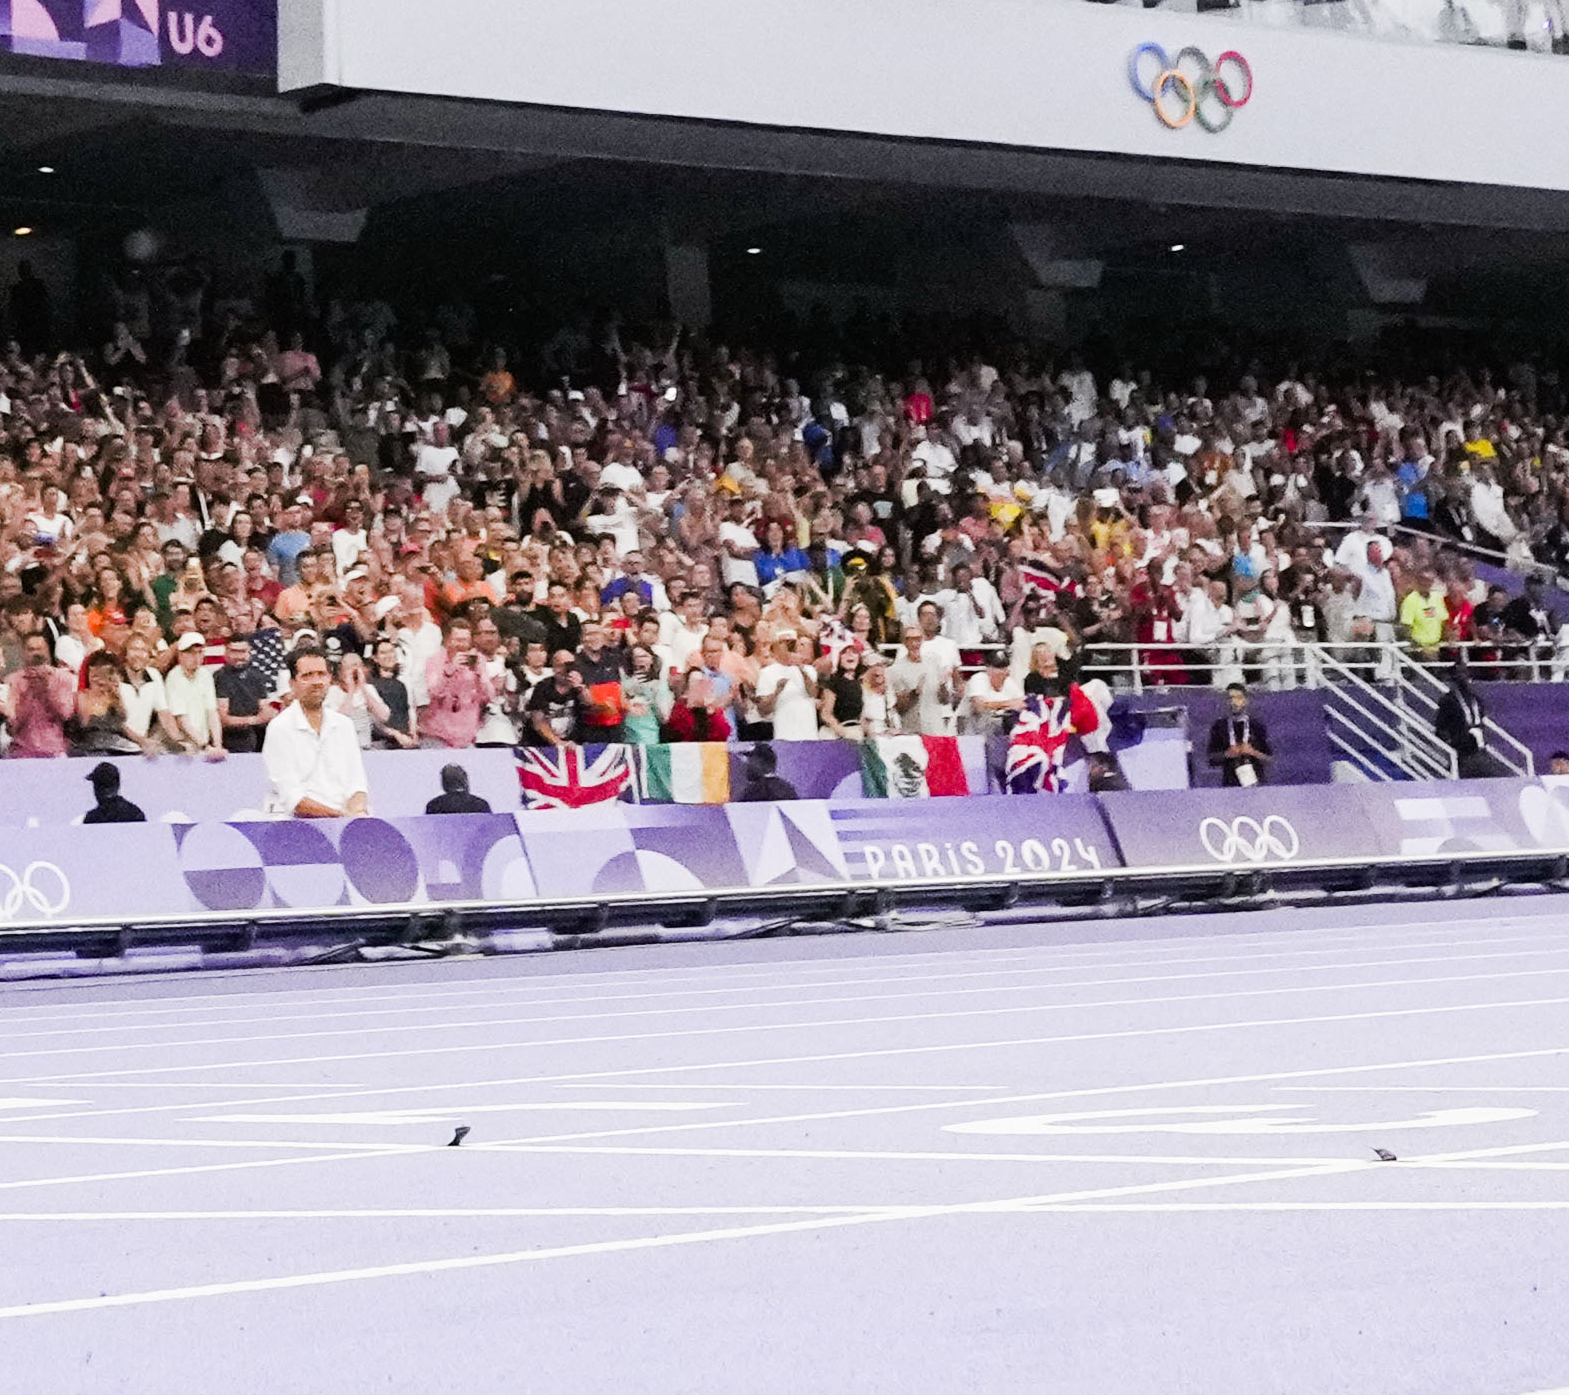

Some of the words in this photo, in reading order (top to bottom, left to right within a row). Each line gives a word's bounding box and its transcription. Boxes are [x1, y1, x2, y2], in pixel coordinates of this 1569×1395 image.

[167, 10, 224, 58] U6
[862, 840, 985, 880] PARIS
[994, 837, 1102, 872] 2024
